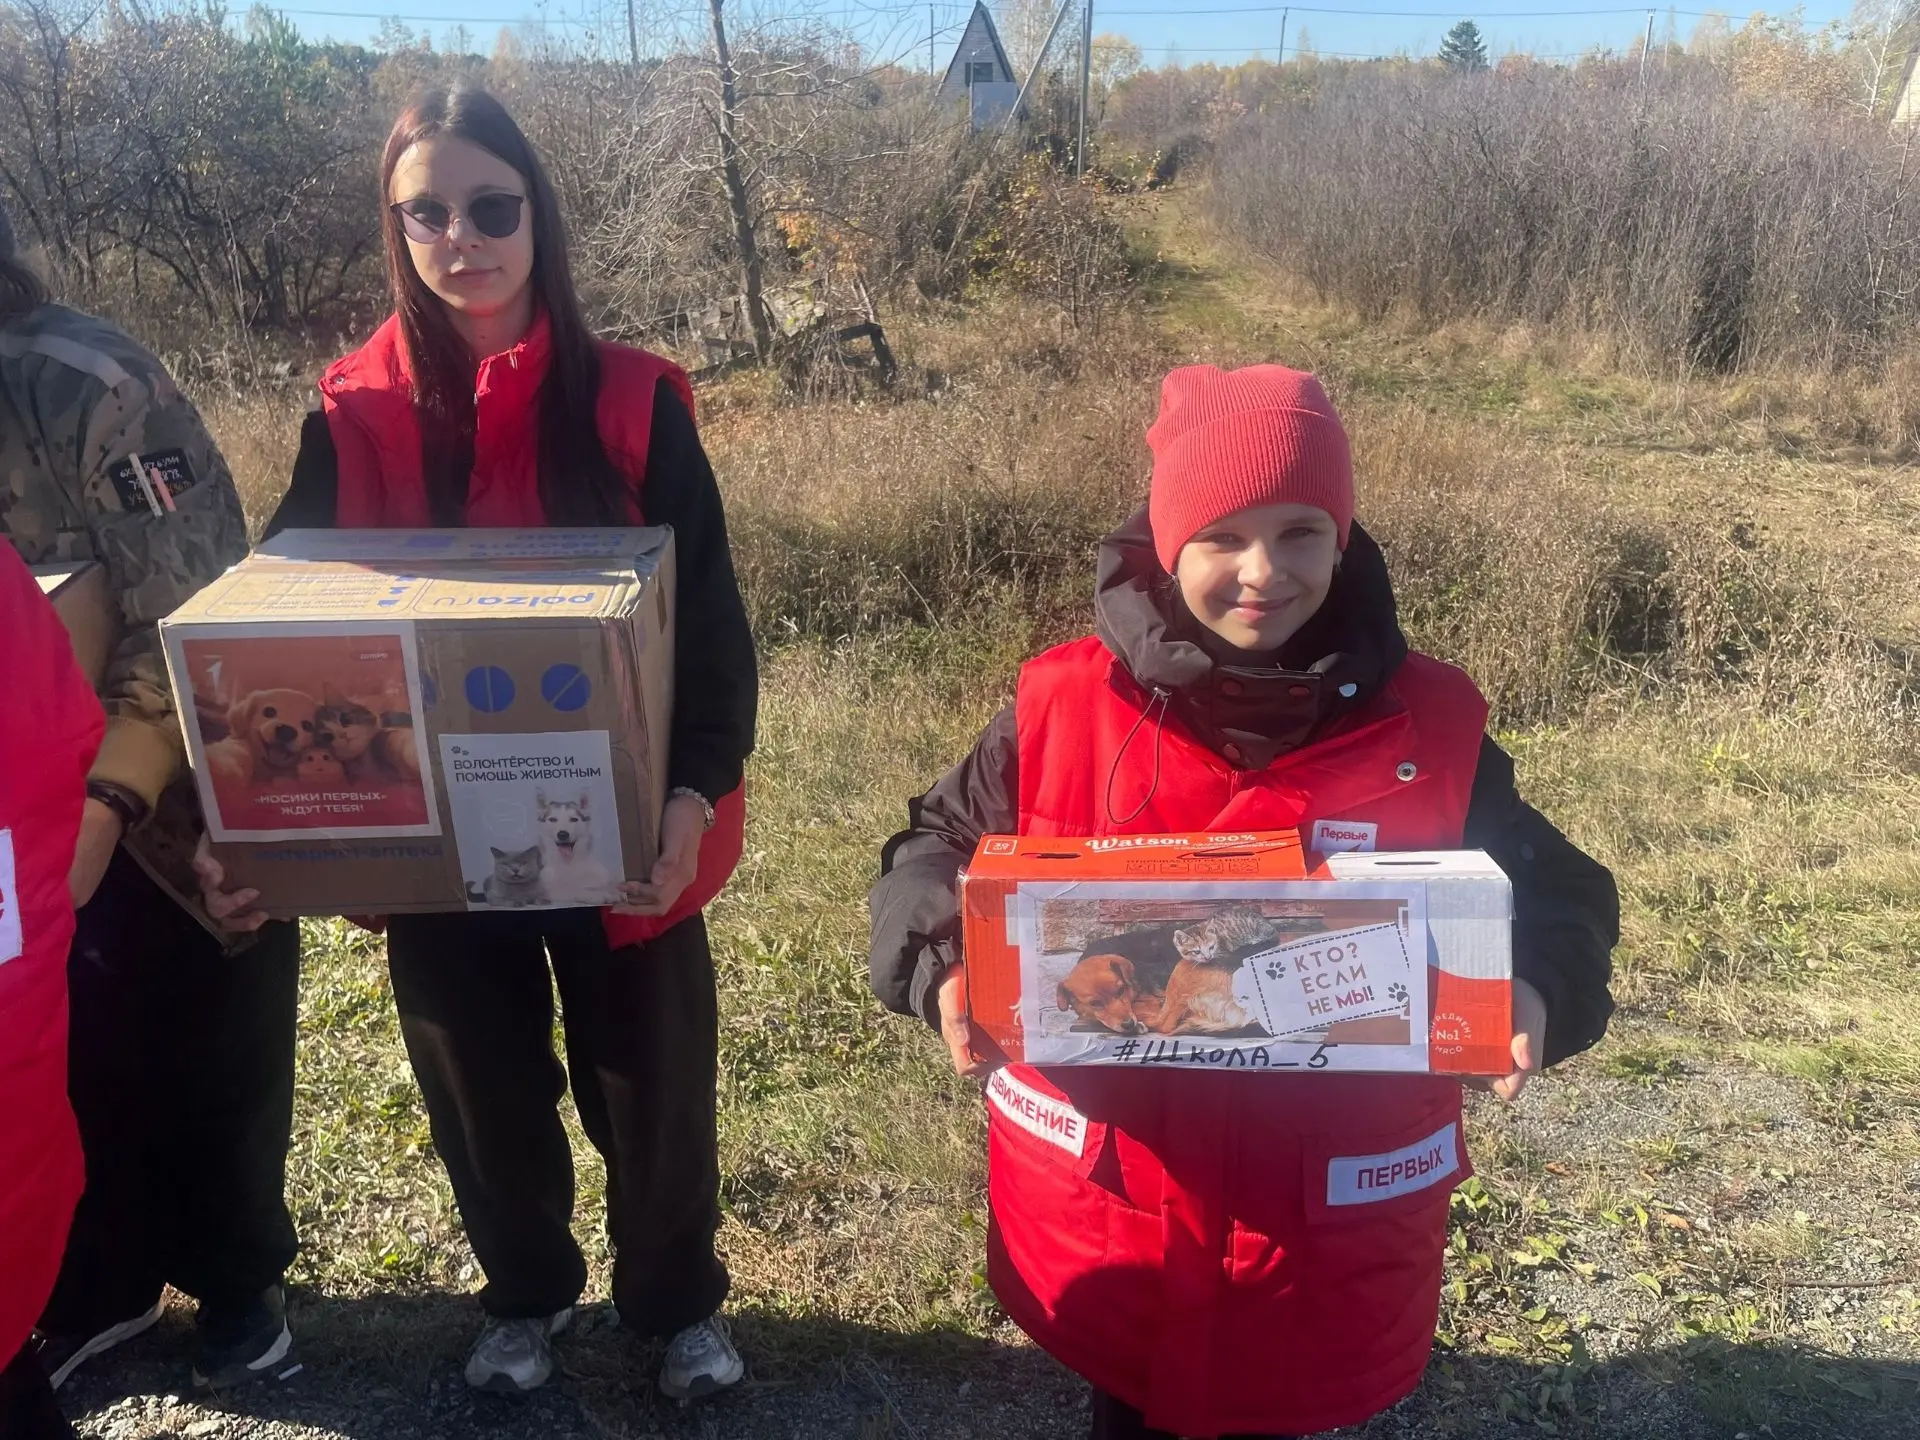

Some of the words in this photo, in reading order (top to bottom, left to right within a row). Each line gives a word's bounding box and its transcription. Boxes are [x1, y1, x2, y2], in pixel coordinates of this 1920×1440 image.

[453, 755, 562, 770] ВОЛОНТЁРСТВО
[564, 755, 575, 766] И
[455, 769, 518, 783] ПОМОЩЬ
[520, 767, 601, 780] ЖИВОТНЫМ
[280, 804, 321, 816] ЖДУТ
[323, 802, 365, 813] ТЕБЯ!
[1085, 835, 1190, 851] Watson
[1206, 834, 1257, 843] 100%
[1320, 827, 1368, 842] Первые
[1294, 941, 1358, 973] КТО?
[1300, 963, 1368, 995] ЕСЛИ
[1306, 995, 1333, 1017] НЕ
[1335, 985, 1374, 1010] МЫ!
[1435, 1045, 1463, 1055] МЯСО
[991, 1071, 1078, 1140] ДВИЖЕНИЕ
[1356, 1143, 1445, 1190] ПЕРВЫХ
